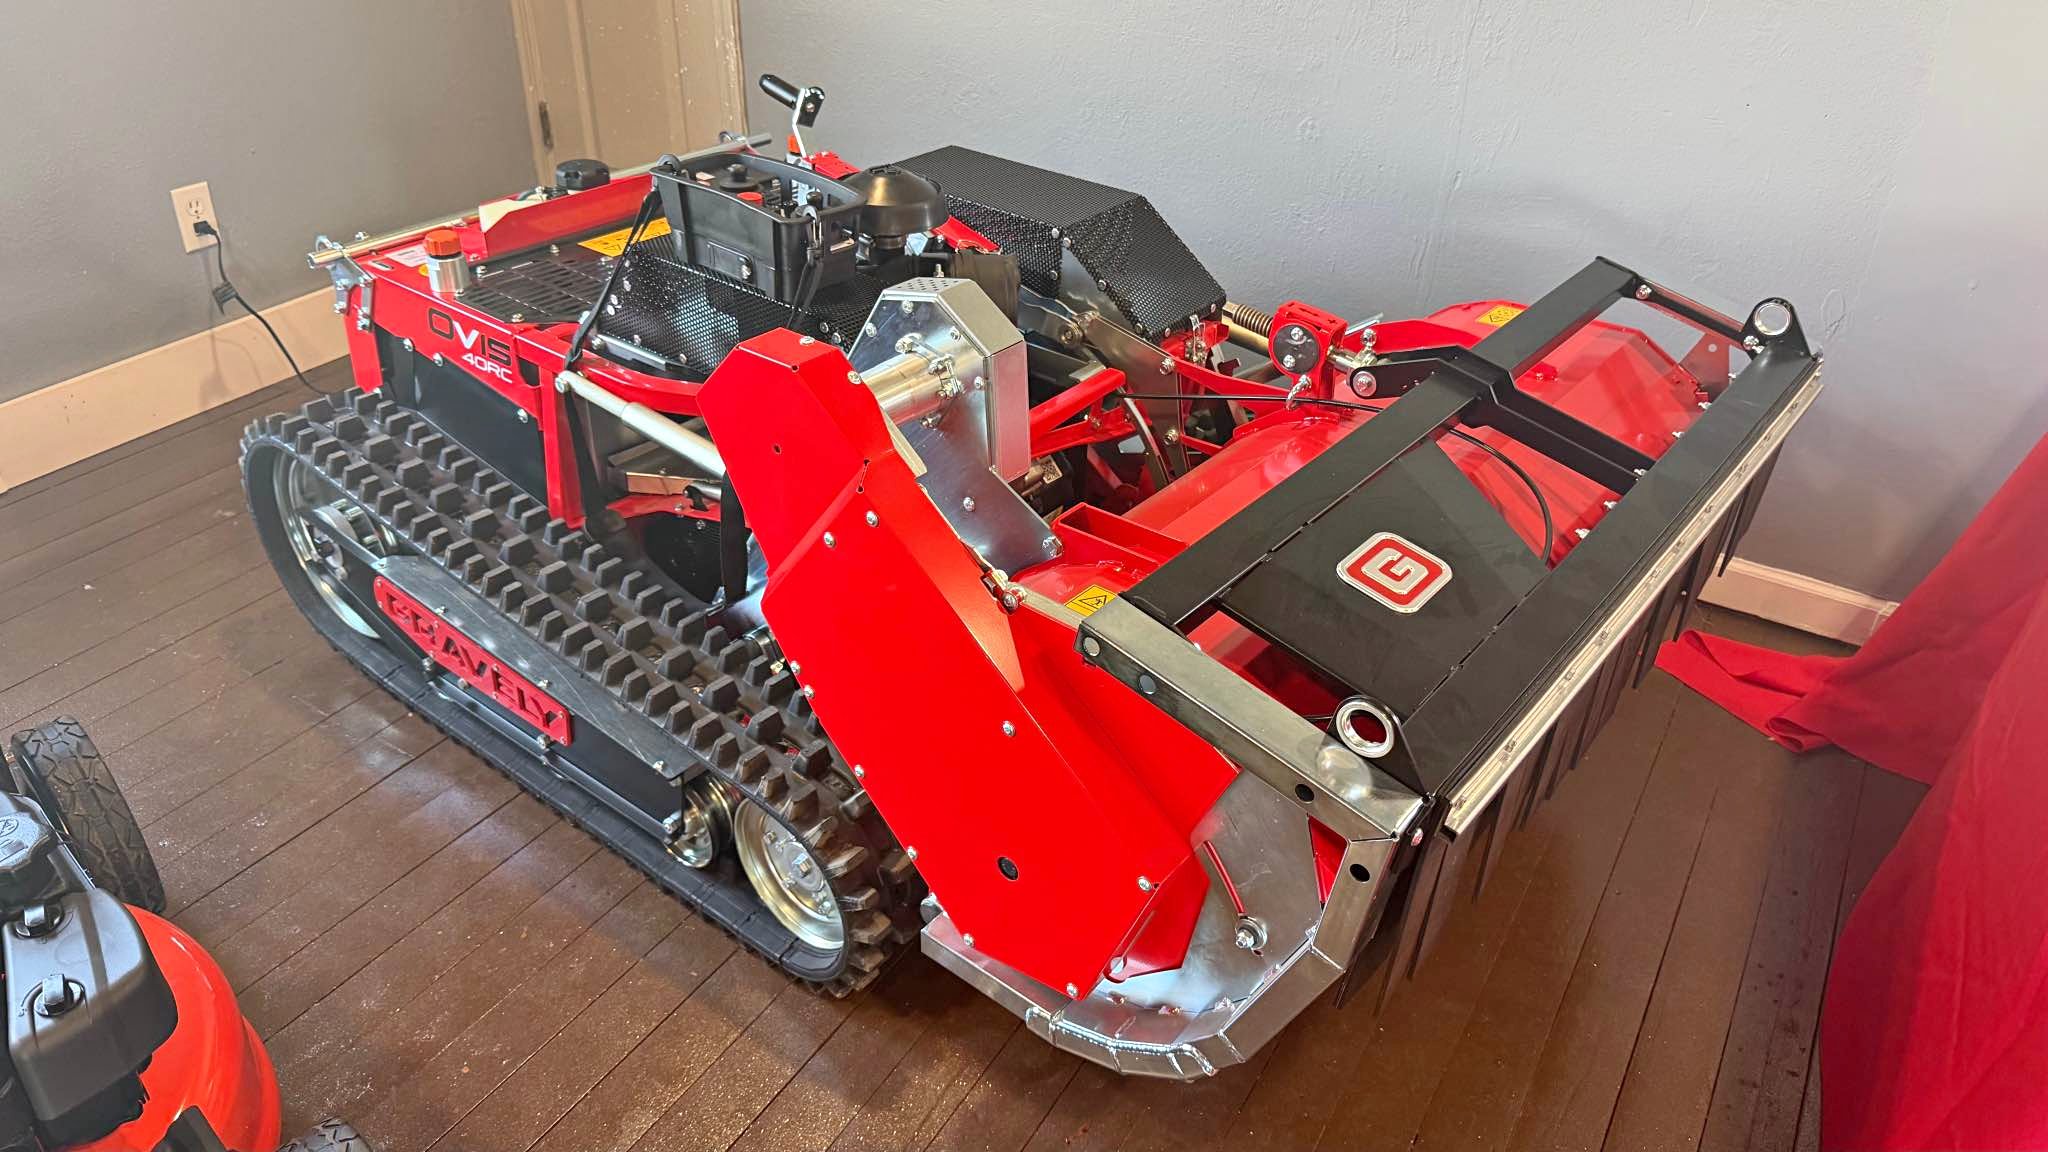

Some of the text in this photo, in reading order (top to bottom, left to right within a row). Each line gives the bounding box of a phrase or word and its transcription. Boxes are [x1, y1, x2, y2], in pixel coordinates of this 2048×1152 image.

[428, 307, 512, 366] OVIS
[462, 352, 513, 384] 40RC
[1360, 547, 1429, 595] G
[385, 591, 560, 730] GRAVELY
